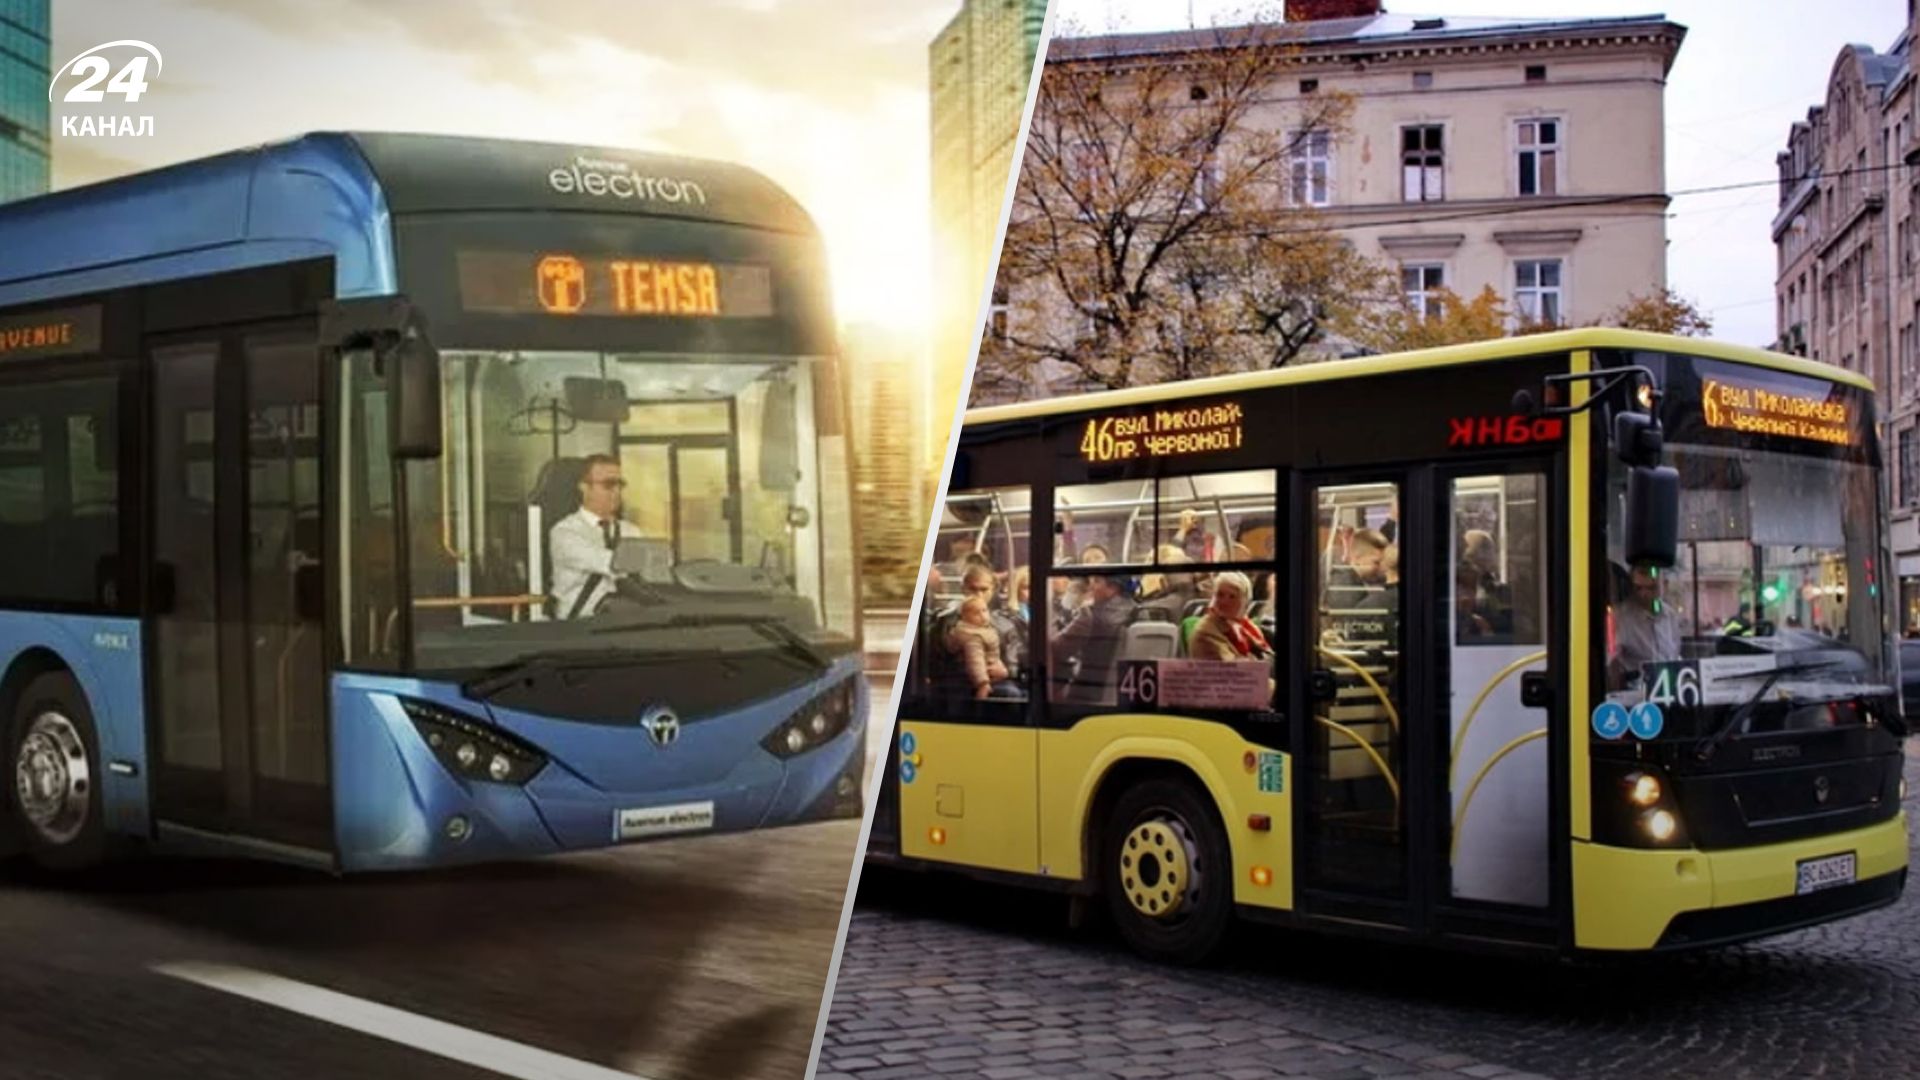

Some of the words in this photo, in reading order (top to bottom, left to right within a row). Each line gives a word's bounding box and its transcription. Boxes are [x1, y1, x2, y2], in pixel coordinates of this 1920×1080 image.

[549, 164, 705, 204] electron
[610, 260, 719, 314] TEMSA
[1080, 418, 1114, 461] 46
[1119, 665, 1156, 703] 46
[1649, 666, 1700, 707] 46
